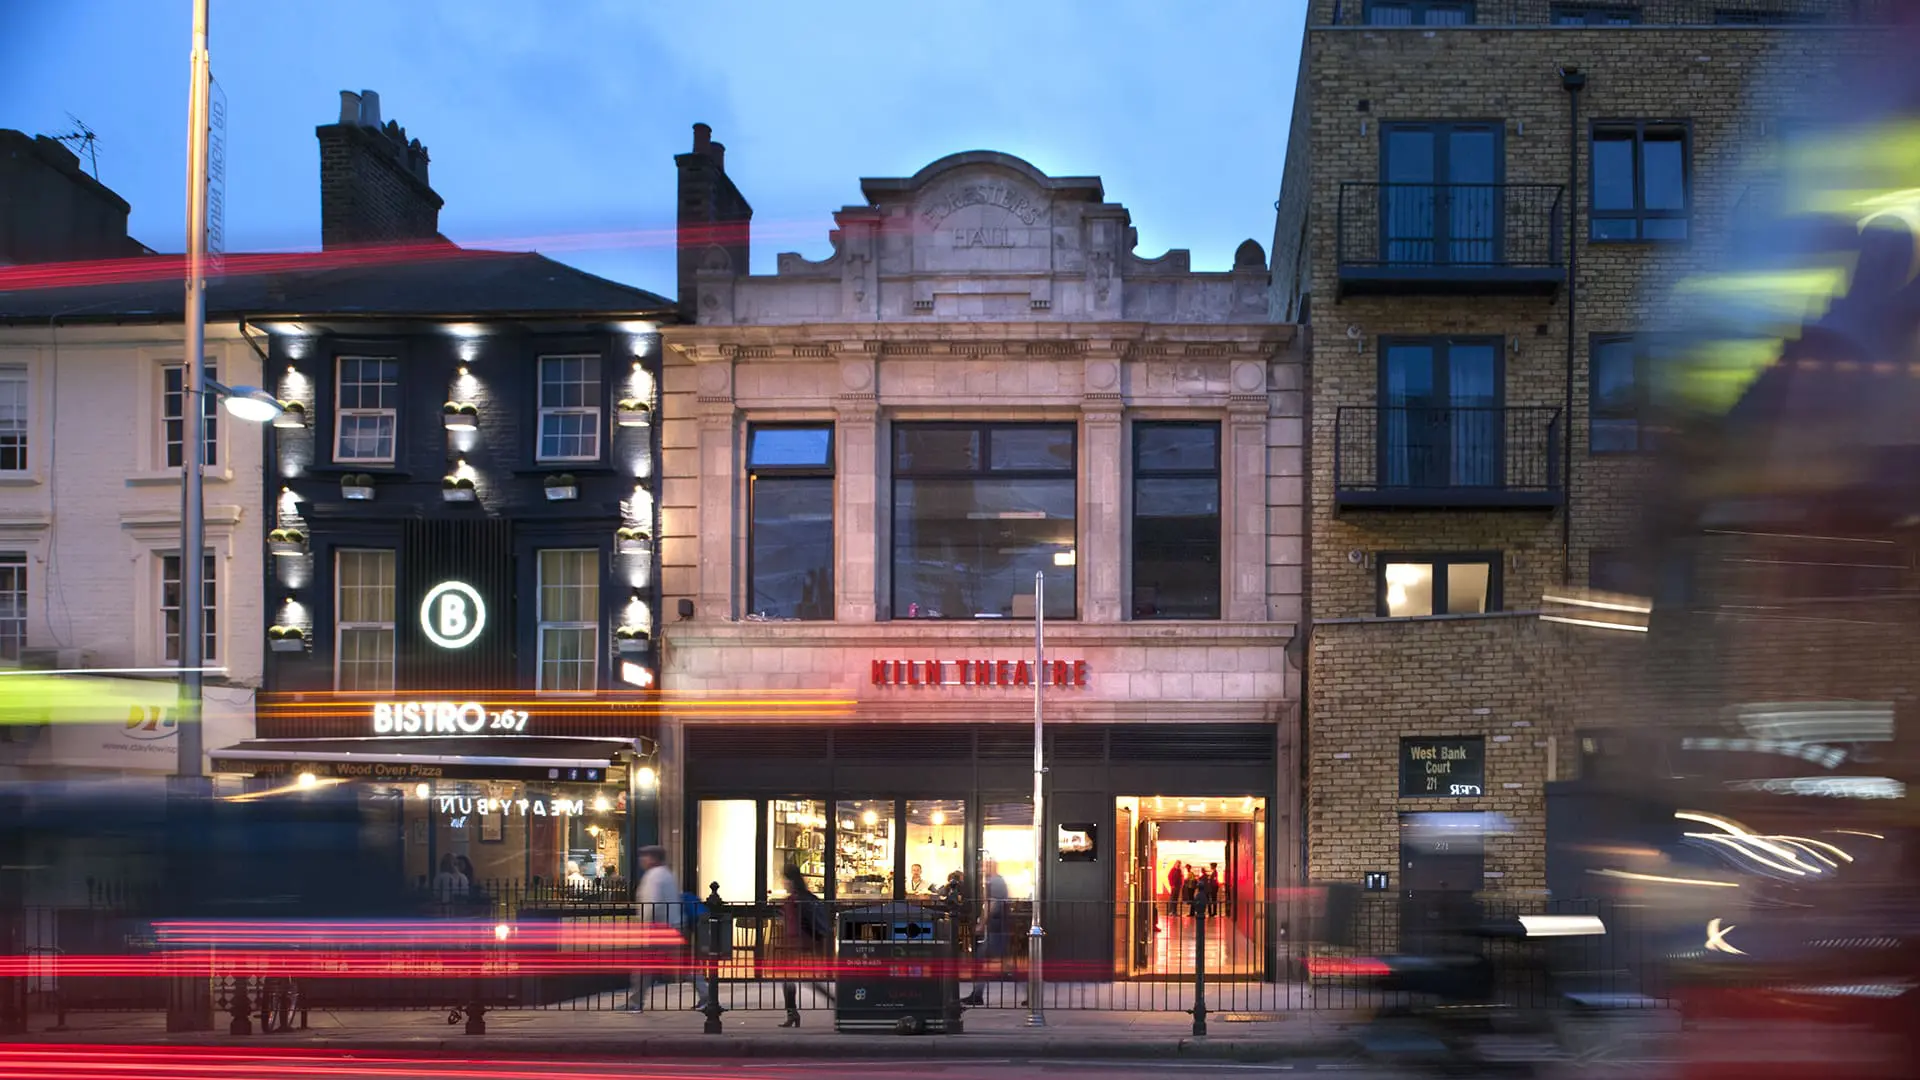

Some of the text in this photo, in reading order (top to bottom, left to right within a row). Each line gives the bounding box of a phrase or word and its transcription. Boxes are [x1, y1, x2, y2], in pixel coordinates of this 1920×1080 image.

[952, 228, 1014, 249] HALL
[440, 593, 467, 636] B
[871, 660, 941, 685] KILN
[374, 701, 528, 733] BISTRO 267
[1411, 747, 1466, 760] West Bank
[337, 764, 371, 775] Wood
[375, 764, 407, 775] Oven
[410, 765, 443, 777] Pizza
[1426, 761, 1451, 774] Court
[1427, 777, 1437, 791] 271
